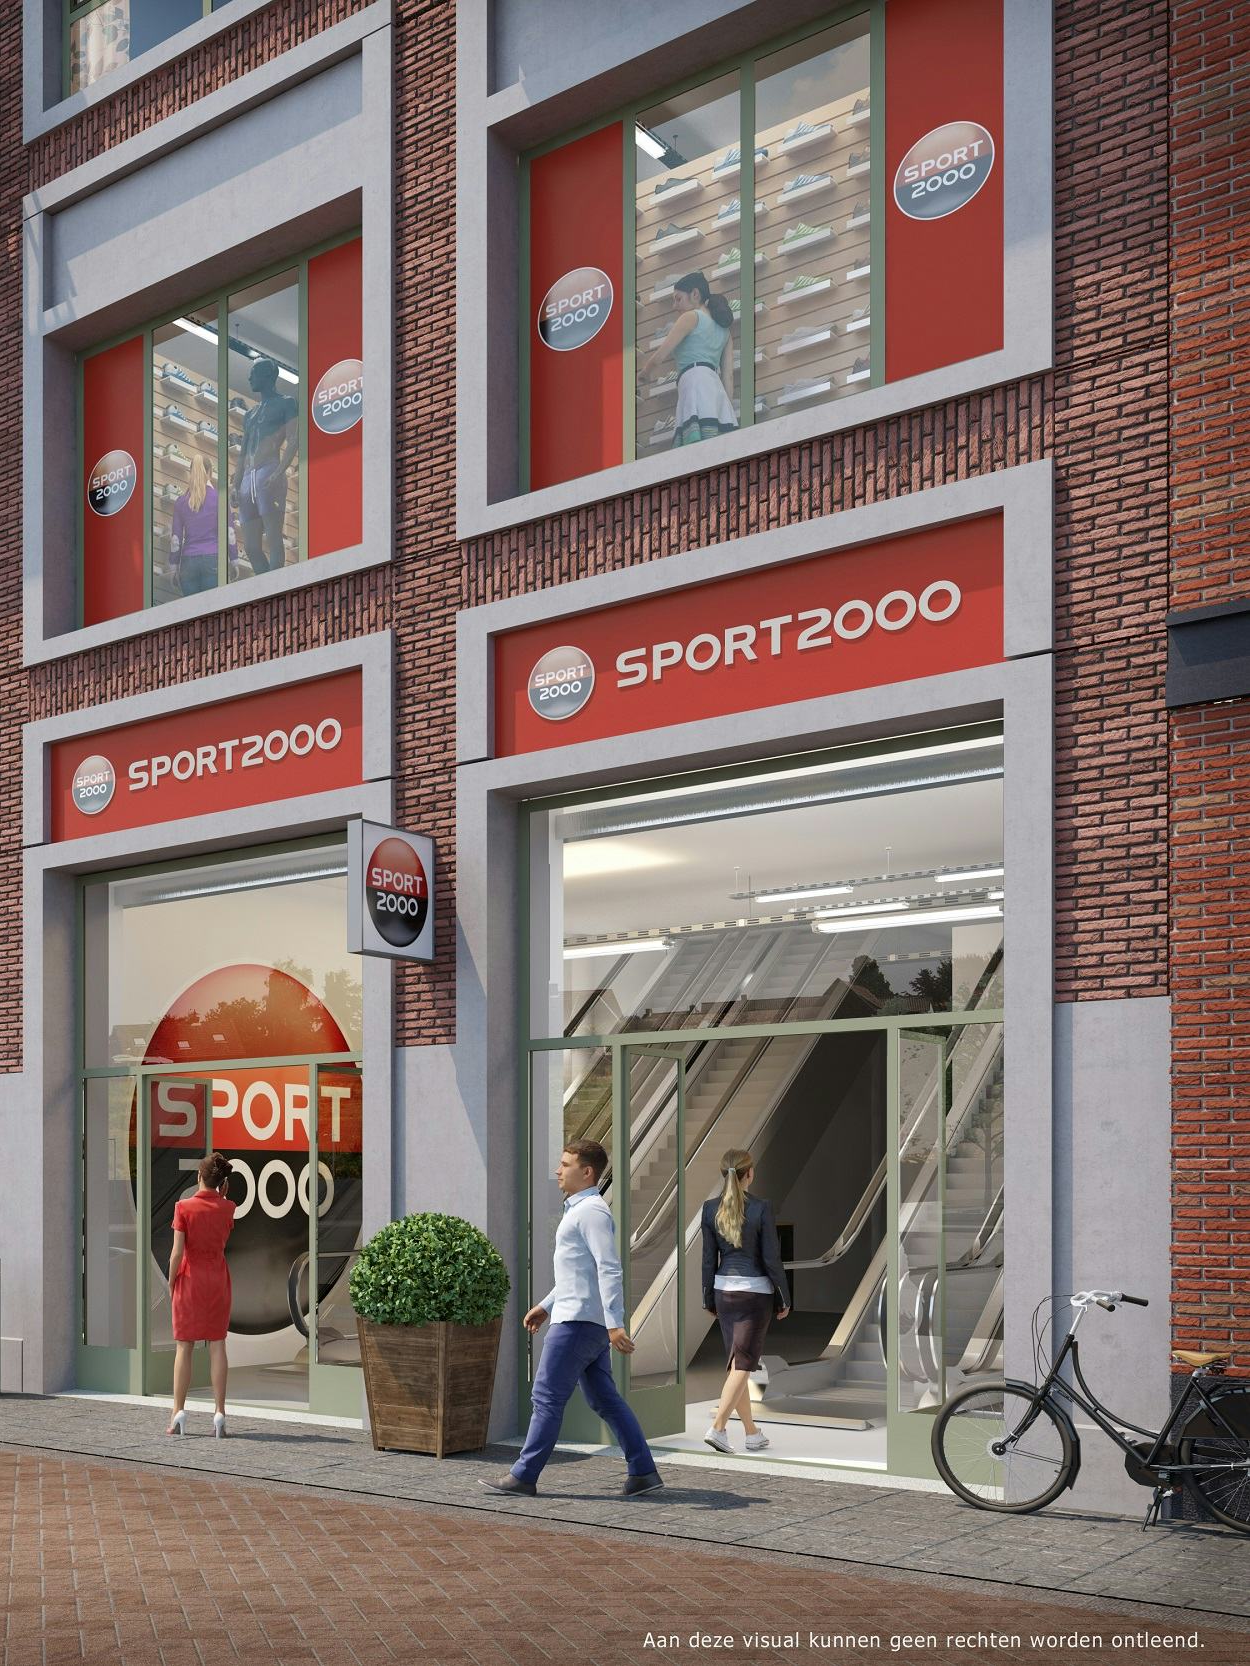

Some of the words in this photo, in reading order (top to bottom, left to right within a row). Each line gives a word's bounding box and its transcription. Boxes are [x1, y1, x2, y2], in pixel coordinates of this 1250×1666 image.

[903, 139, 985, 183] SPORT
[911, 163, 976, 199] 2000
[545, 283, 606, 319] SPORT
[550, 303, 600, 332] 2000
[318, 376, 363, 404] SPORT
[322, 394, 362, 417] 2000
[92, 464, 132, 489] SPORT
[96, 480, 128, 501] 2000
[616, 580, 962, 688] SPORT2000
[534, 664, 587, 687] SPORT
[539, 681, 582, 700] 2000
[128, 717, 342, 791] SPORT2000
[76, 770, 110, 788] SPORT
[79, 783, 107, 798] 2000
[371, 867, 423, 895] SPORT
[376, 891, 419, 917] 2000
[158, 1079, 350, 1143] SPORT
